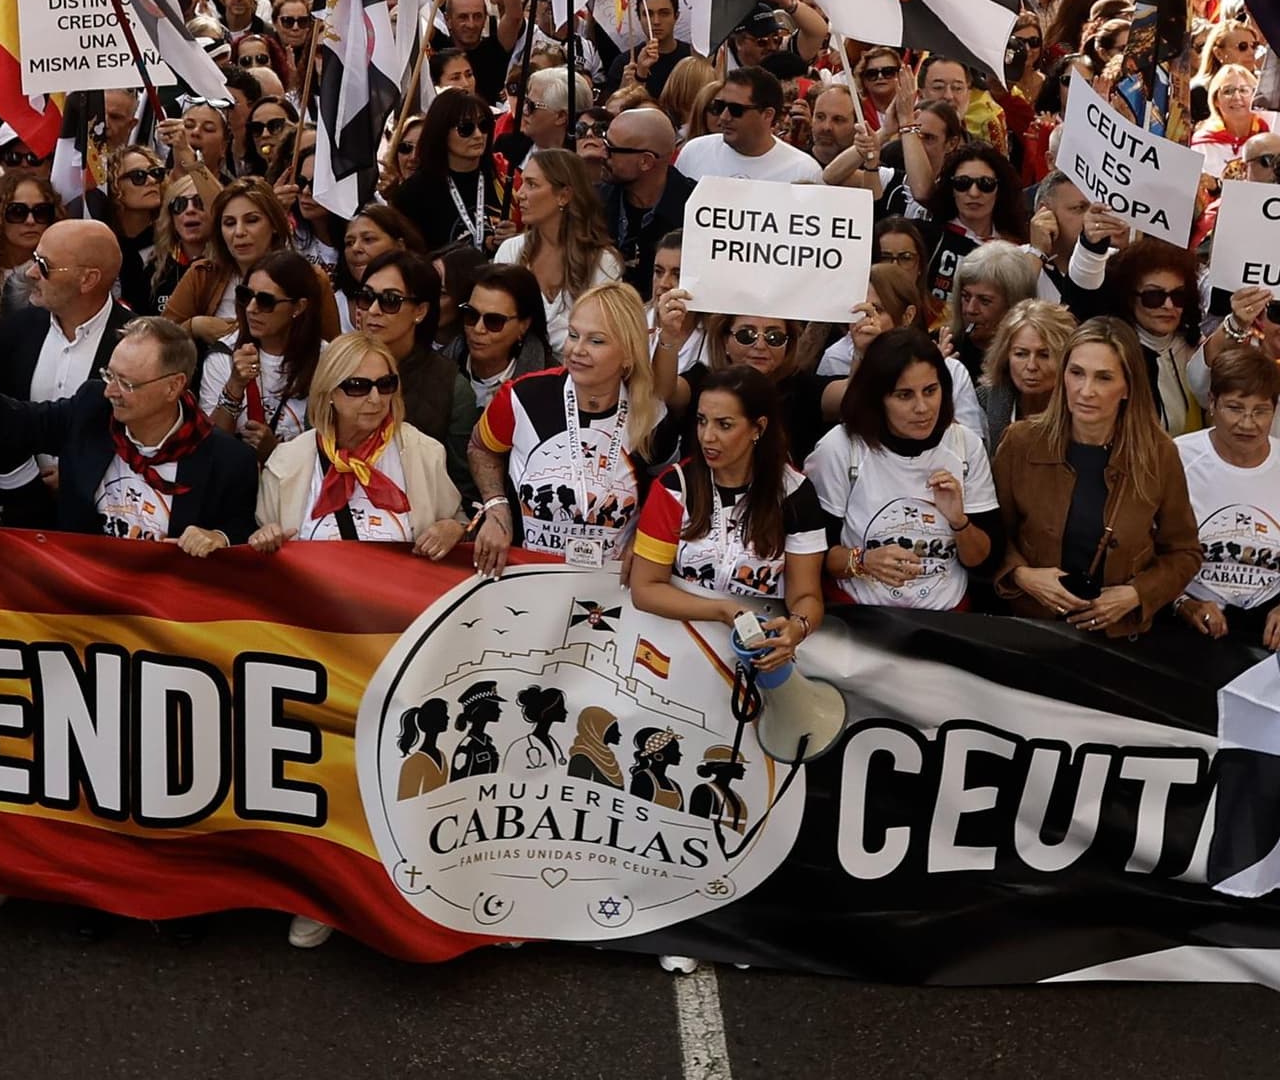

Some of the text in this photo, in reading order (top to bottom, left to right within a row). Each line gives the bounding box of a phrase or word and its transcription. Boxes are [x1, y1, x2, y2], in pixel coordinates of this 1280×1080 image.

[79, 33, 118, 50] UNA
[29, 56, 91, 74] MISMA
[1086, 103, 1161, 171] CEUTA
[1101, 151, 1132, 186] ES
[1074, 153, 1171, 231] EUROPA
[695, 206, 862, 240] CEUTA ES EL
[711, 238, 843, 270] PRINCIPIO
[542, 522, 603, 537] MUJERES
[478, 783, 650, 822] MUJERES
[836, 724, 1219, 883] CEUT
[428, 804, 710, 869] CABALLAS
[460, 848, 669, 879] FAMILIAS UNIDAS POR CEUTA
